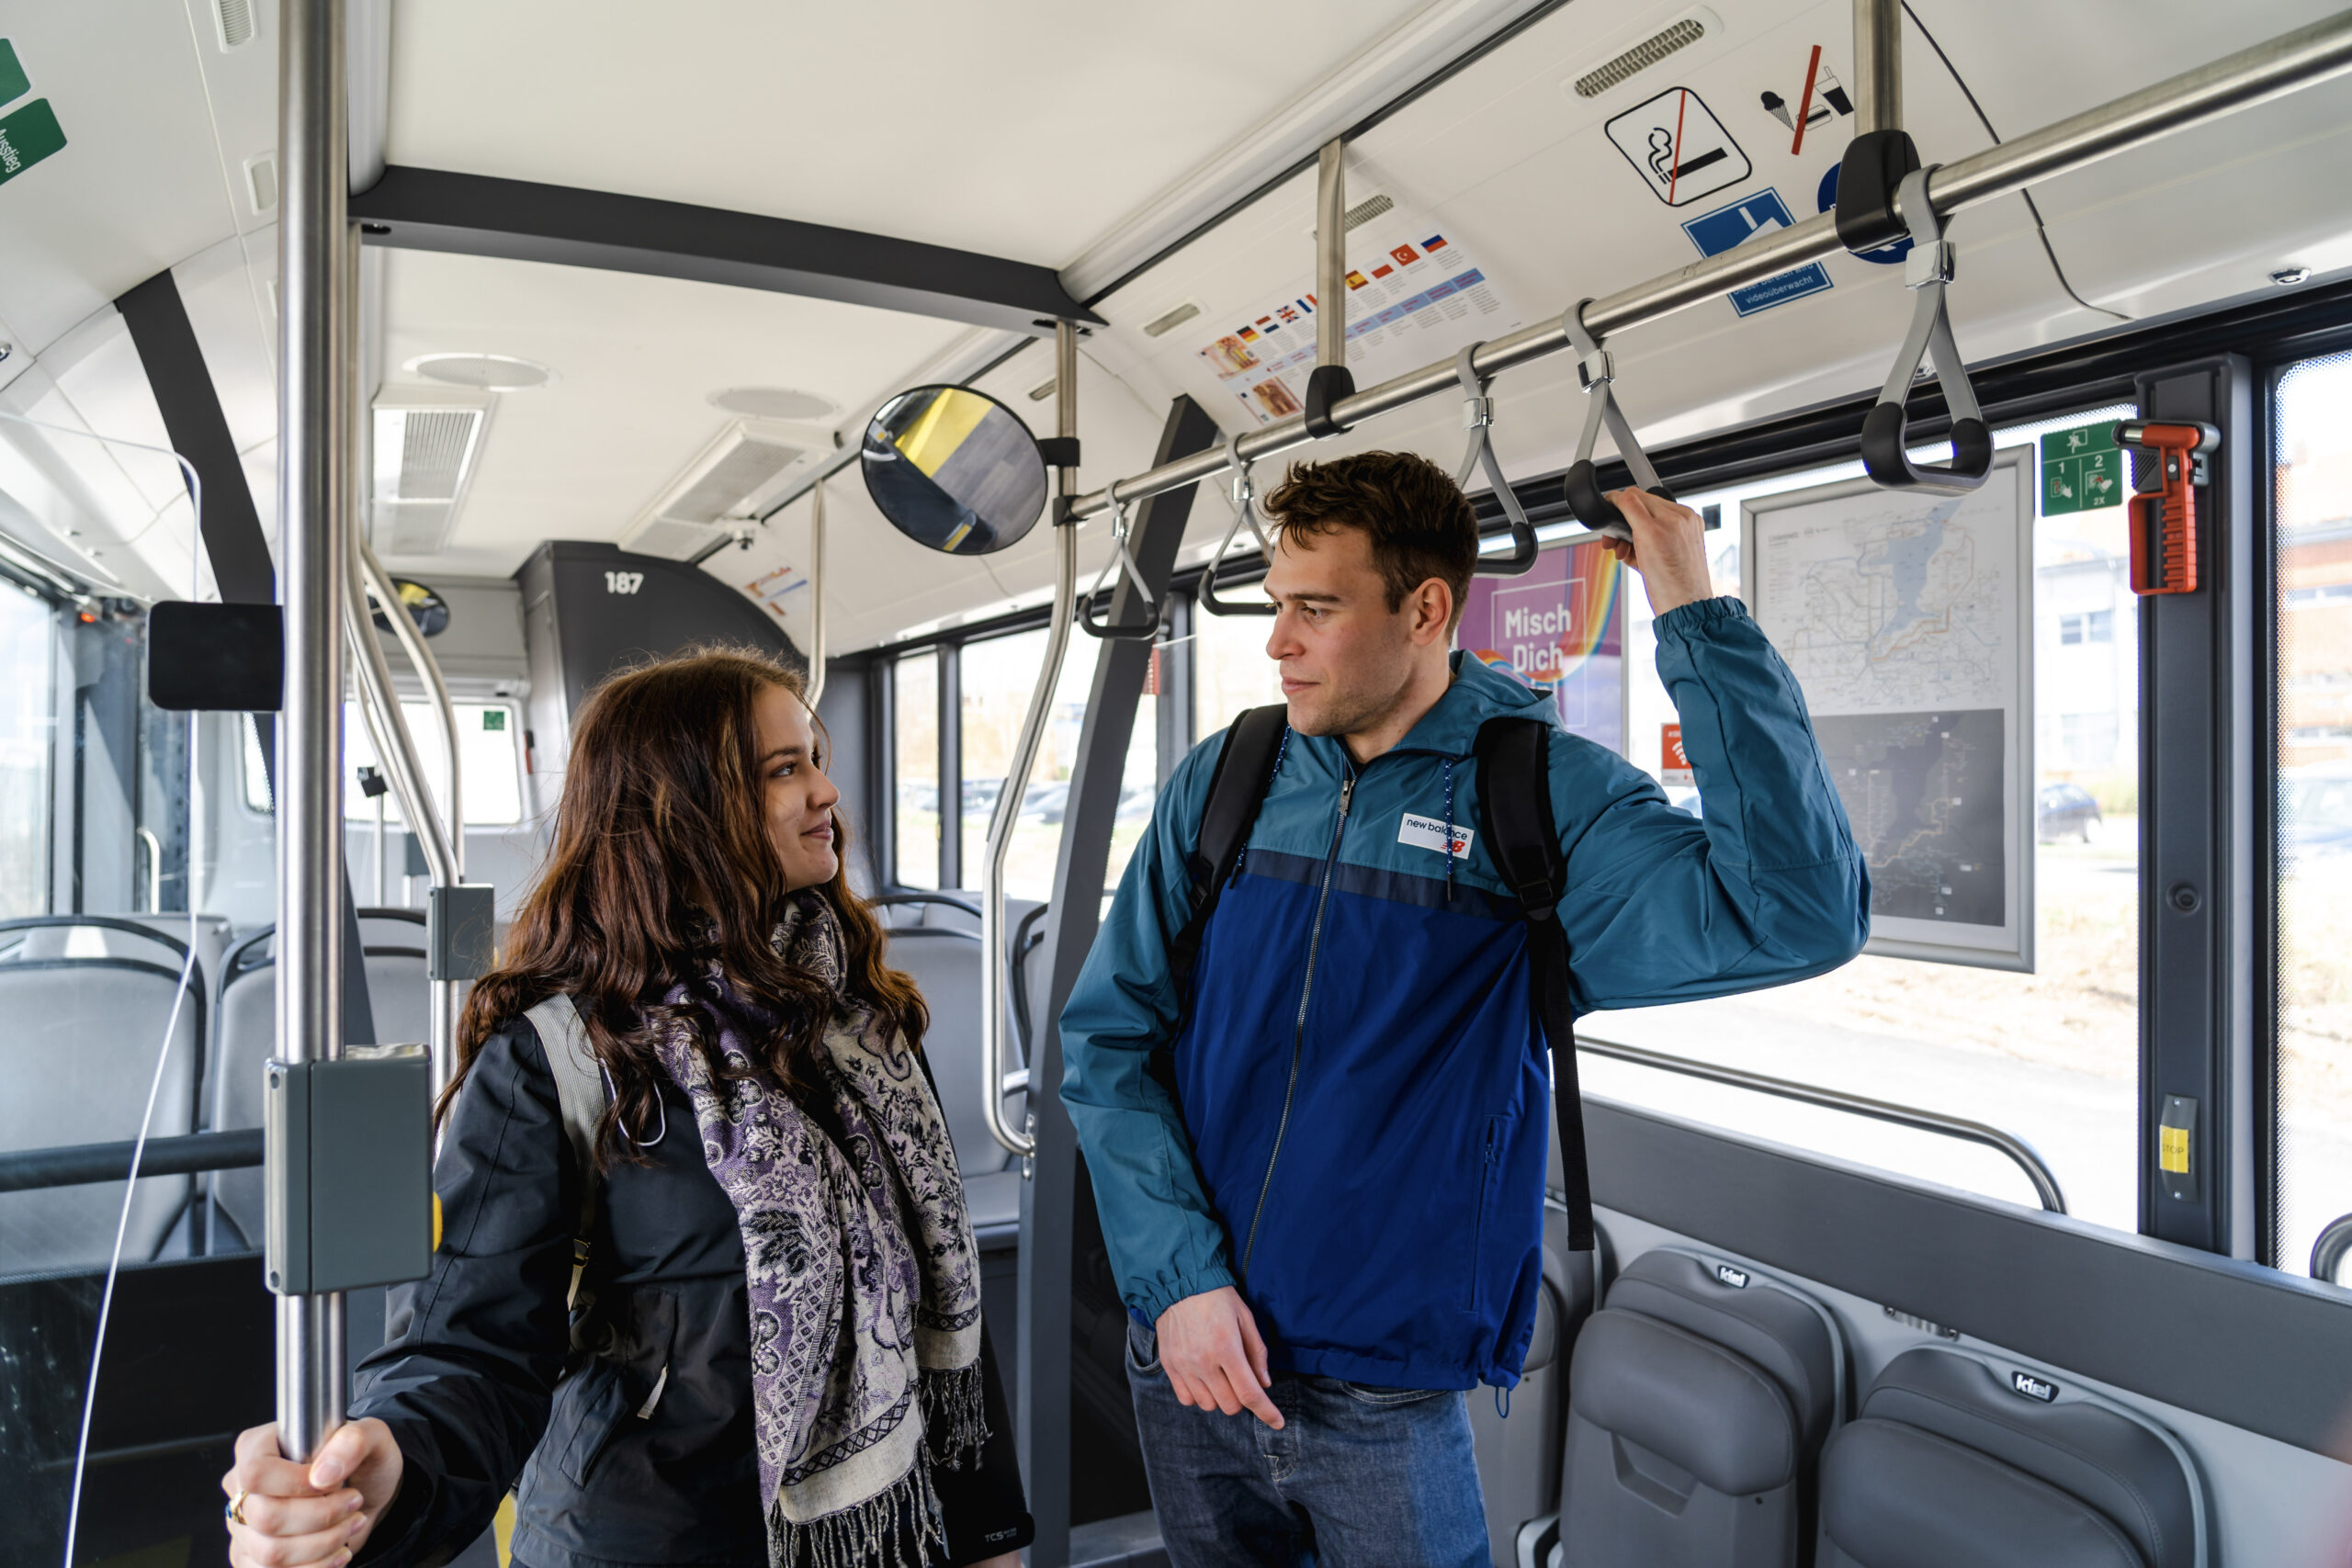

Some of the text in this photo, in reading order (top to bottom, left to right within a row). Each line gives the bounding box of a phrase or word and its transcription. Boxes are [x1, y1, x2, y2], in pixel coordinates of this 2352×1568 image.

[1745, 275, 1814, 304] videoüberwacht
[2059, 455, 2103, 474] 1 2
[605, 571, 644, 594] 187
[1505, 603, 1571, 638] Misch
[1513, 640, 1563, 672] Dich
[1407, 818, 1427, 829] new
[2162, 1144, 2184, 1155] STOP
[2016, 1374, 2051, 1400] kiel
